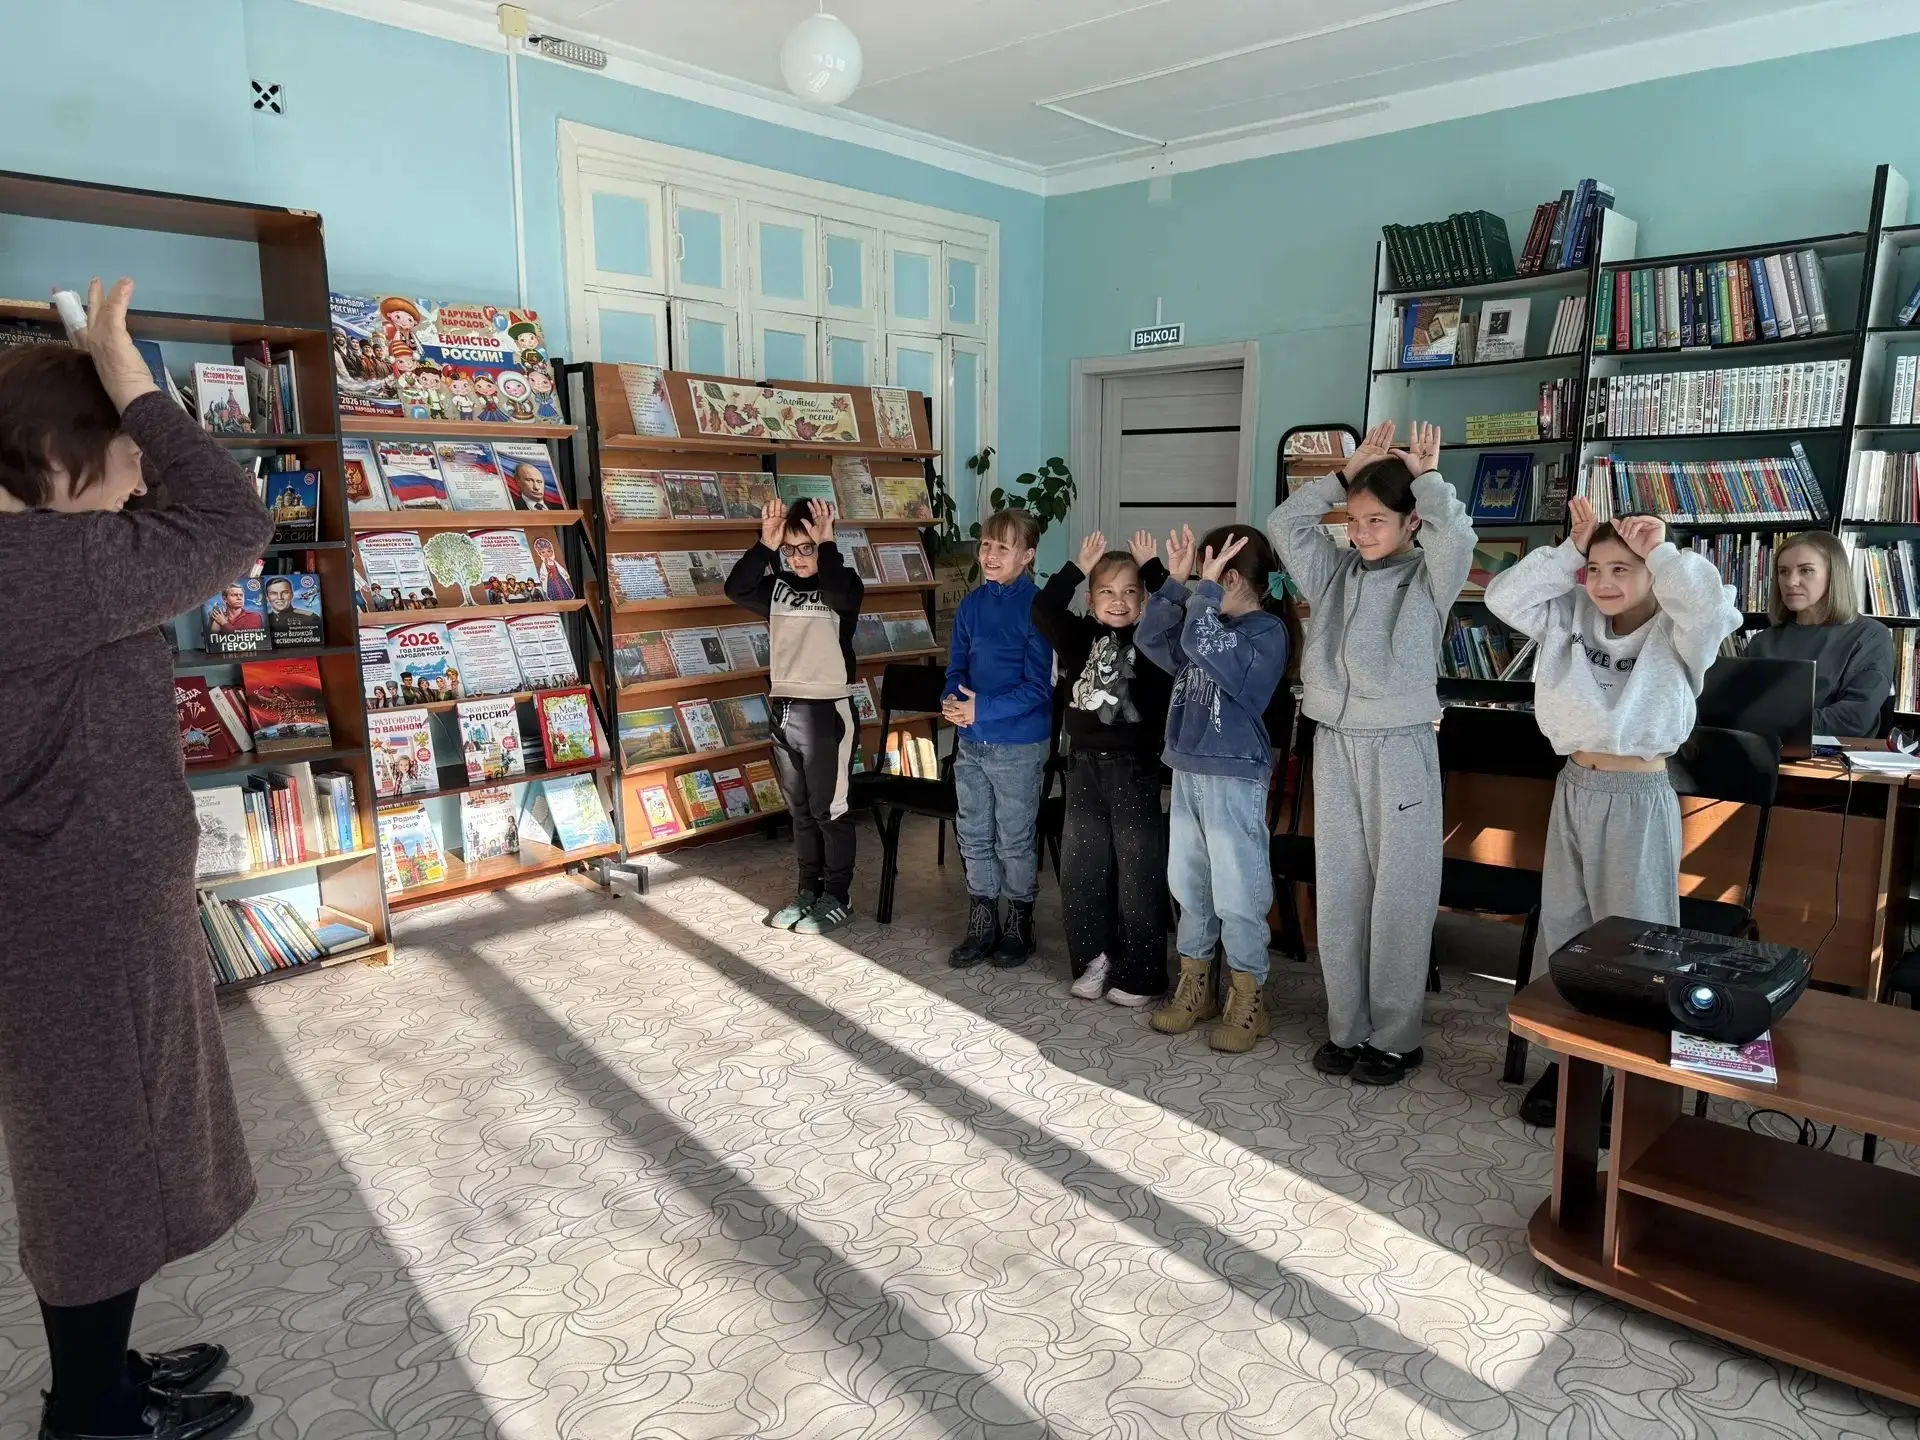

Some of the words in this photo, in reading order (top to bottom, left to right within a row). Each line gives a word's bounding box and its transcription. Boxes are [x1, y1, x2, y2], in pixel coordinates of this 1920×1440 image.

[448, 310, 482, 319] ДРУЖБЕ
[0, 332, 34, 344] СТОРИЯ
[438, 334, 500, 347] ЕДИНСТВО
[1137, 329, 1178, 344] ВЫХОД
[441, 348, 504, 363] РОССИИ!
[341, 396, 359, 405] 2026
[776, 391, 817, 407] Золотые
[210, 633, 267, 643] ПИОНЕРЫ-
[398, 632, 439, 647] 2026
[222, 641, 256, 651] ГЕРОИ
[559, 704, 577, 714] Моя
[468, 710, 508, 721] РОССИЯ
[374, 716, 421, 726] РАЗГОВОРЫ
[383, 723, 422, 733] ВАЖНОМ
